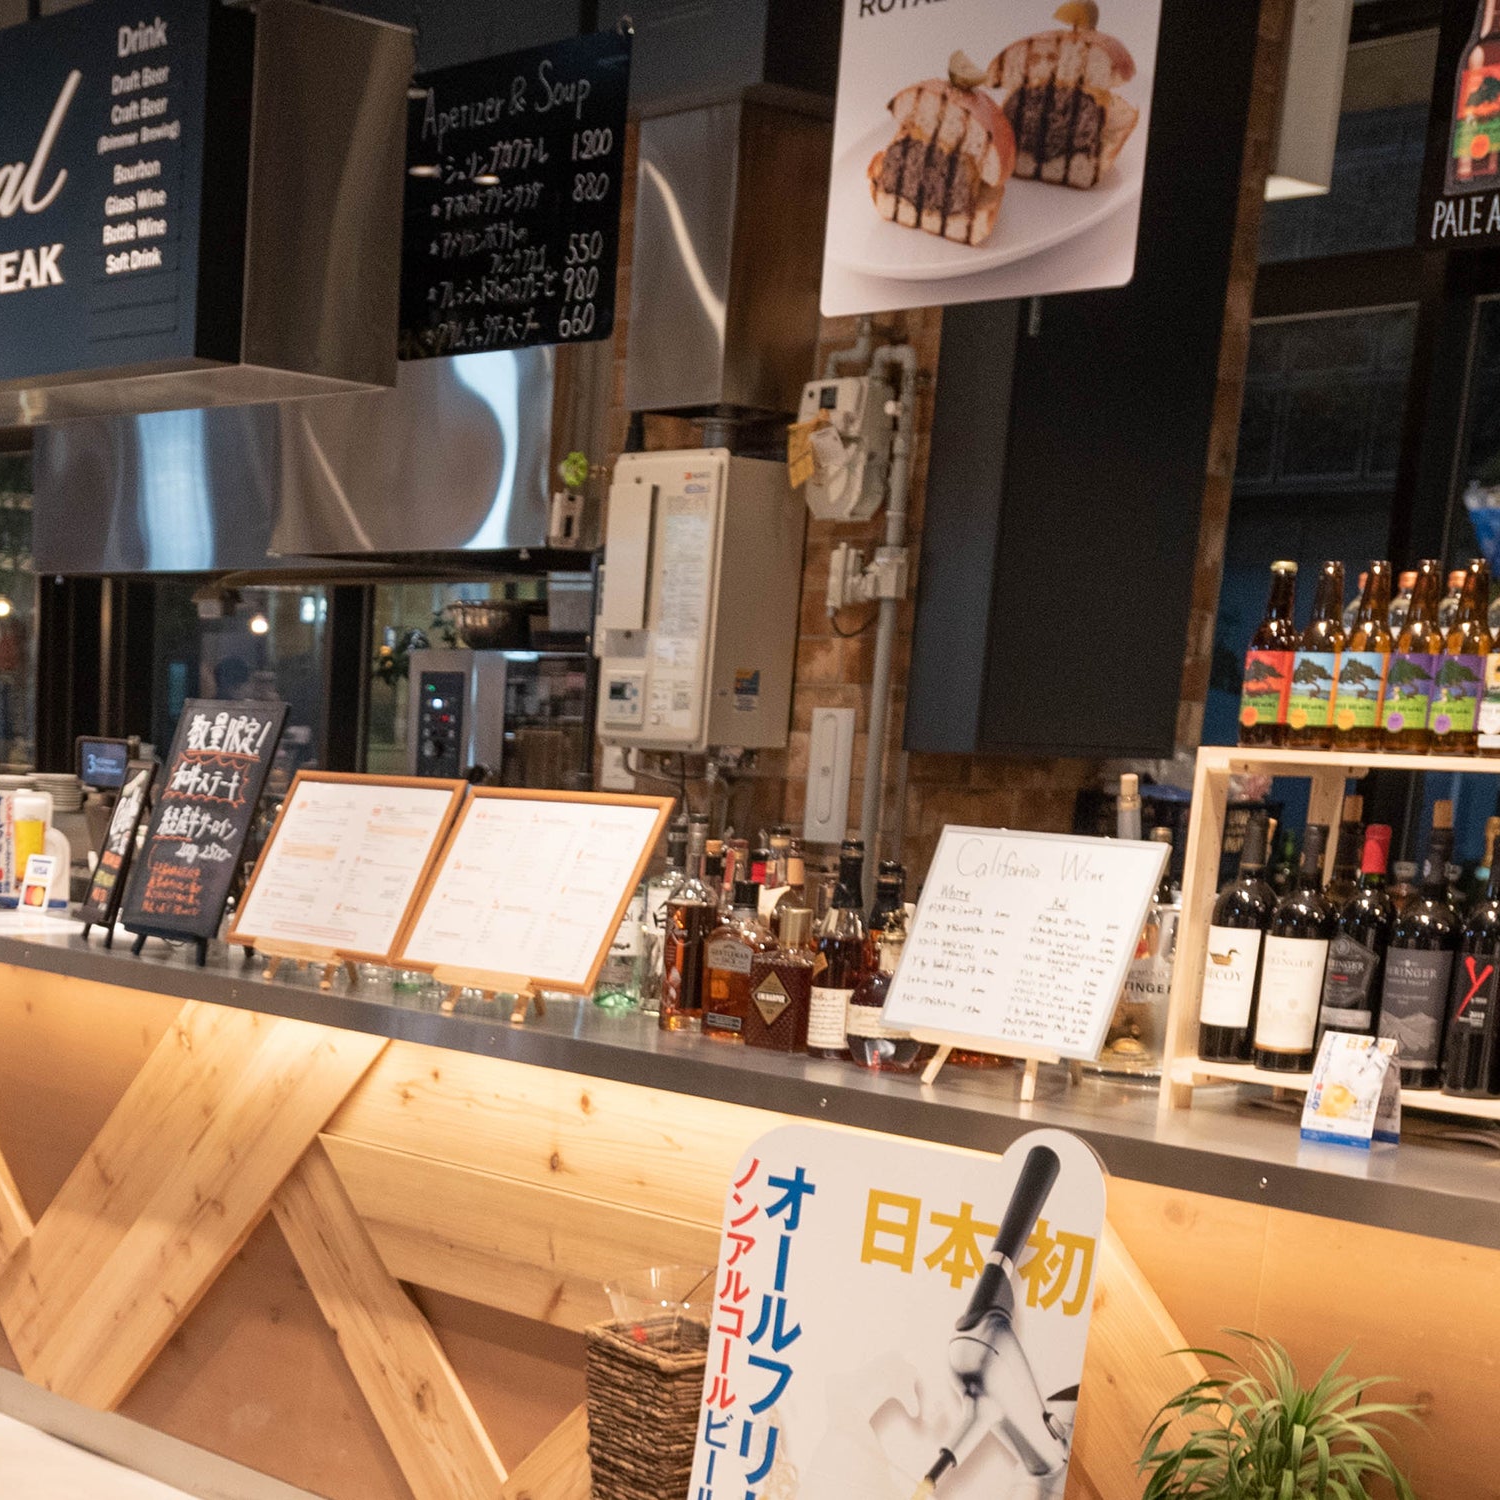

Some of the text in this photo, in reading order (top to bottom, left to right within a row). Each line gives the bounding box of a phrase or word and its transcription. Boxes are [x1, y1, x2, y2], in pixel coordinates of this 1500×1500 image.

[118, 17, 168, 58] Drink
[111, 66, 170, 96] Draft Beer
[508, 75, 527, 116] &
[534, 60, 591, 120] Soup
[111, 97, 168, 126] Craft Beer
[571, 128, 613, 161] 1200
[113, 159, 161, 186] Bourbon
[572, 172, 610, 201] 880
[105, 188, 168, 217] Glass Wine
[1431, 196, 1485, 240] PALE
[103, 217, 168, 246] Bottle Wine
[565, 231, 603, 265] 550
[106, 246, 162, 275] Soft Drink
[563, 266, 598, 302] 980
[559, 302, 595, 338] 660
[956, 838, 1104, 882] California Wine
[860, 1188, 1097, 1317] 日本初
[740, 1166, 816, 1500] オールフリ
